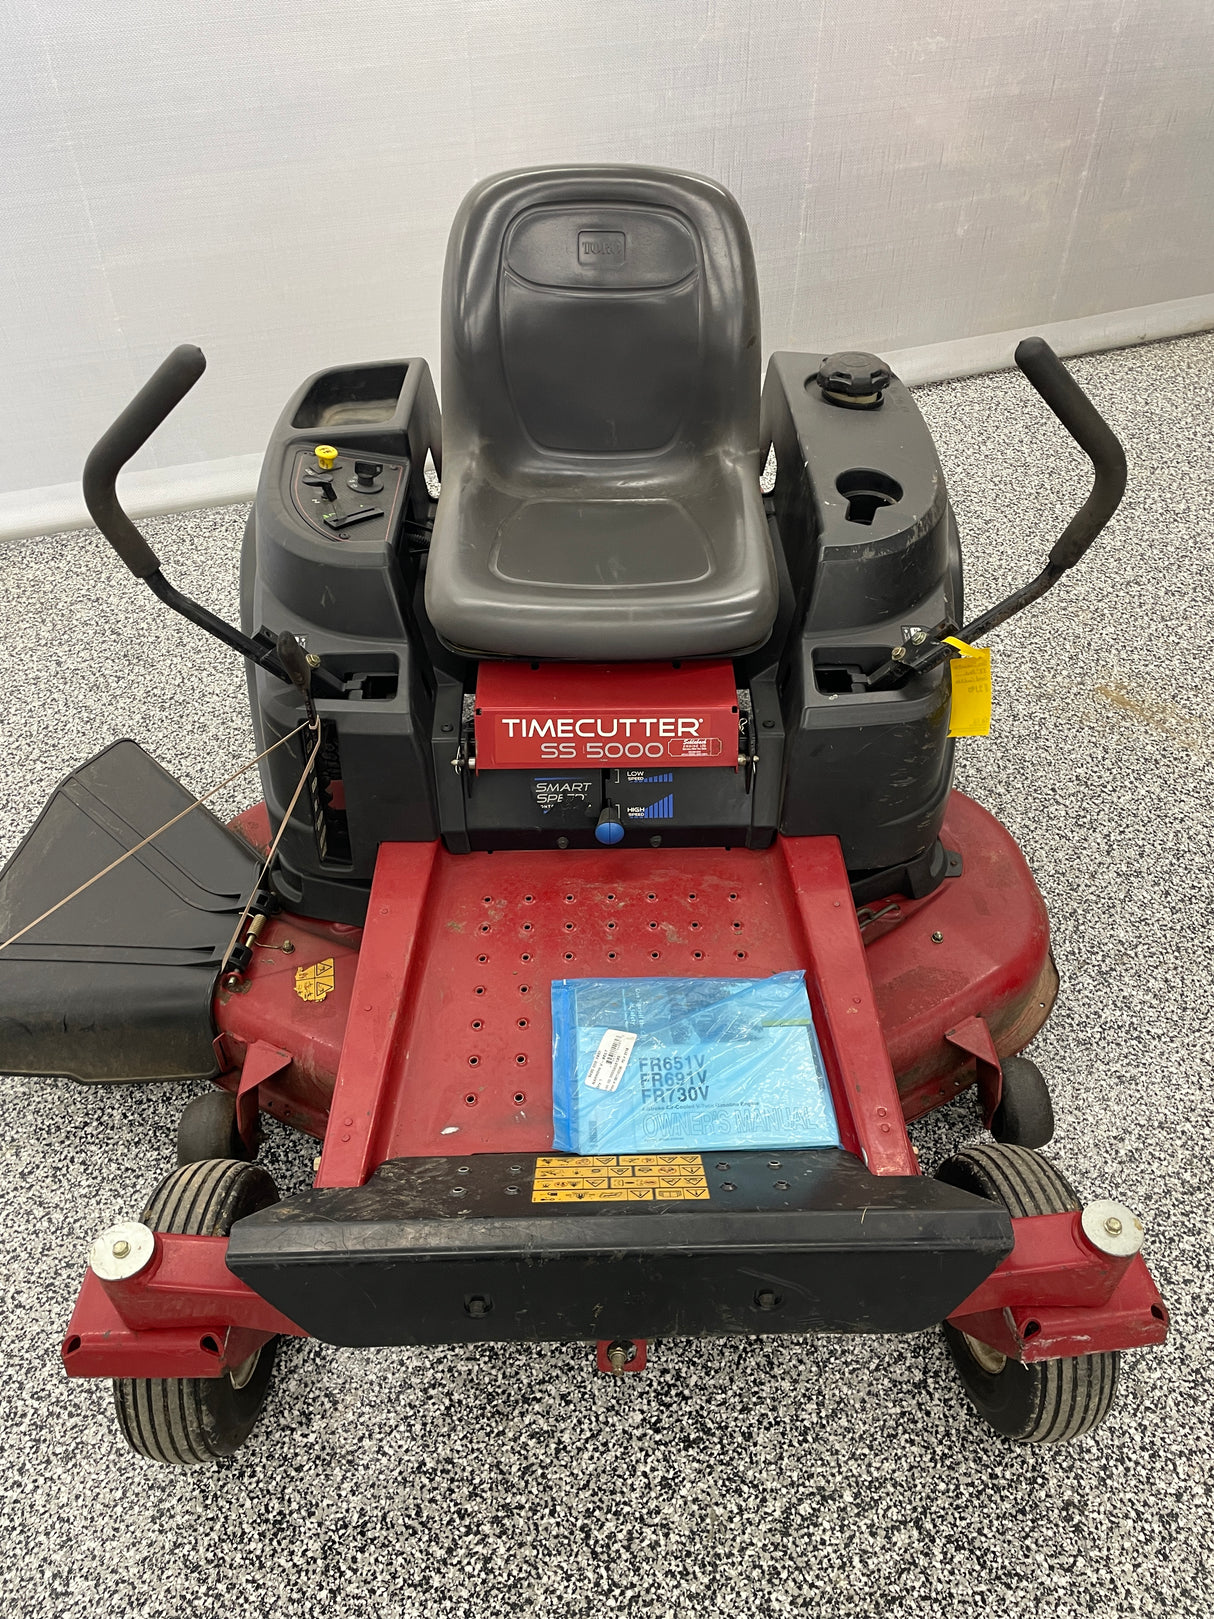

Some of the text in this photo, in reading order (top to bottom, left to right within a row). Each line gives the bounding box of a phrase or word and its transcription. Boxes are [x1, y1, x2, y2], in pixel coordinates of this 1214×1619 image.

[581, 239, 622, 255] TORO
[540, 742, 664, 759] SS 5000
[535, 782, 593, 793] SMART
[638, 1054, 705, 1072] FR651V
[640, 1069, 707, 1088] FR691V
[641, 1085, 709, 1103] FR730V
[642, 1105, 819, 1138] OWNER'S MANUAL
